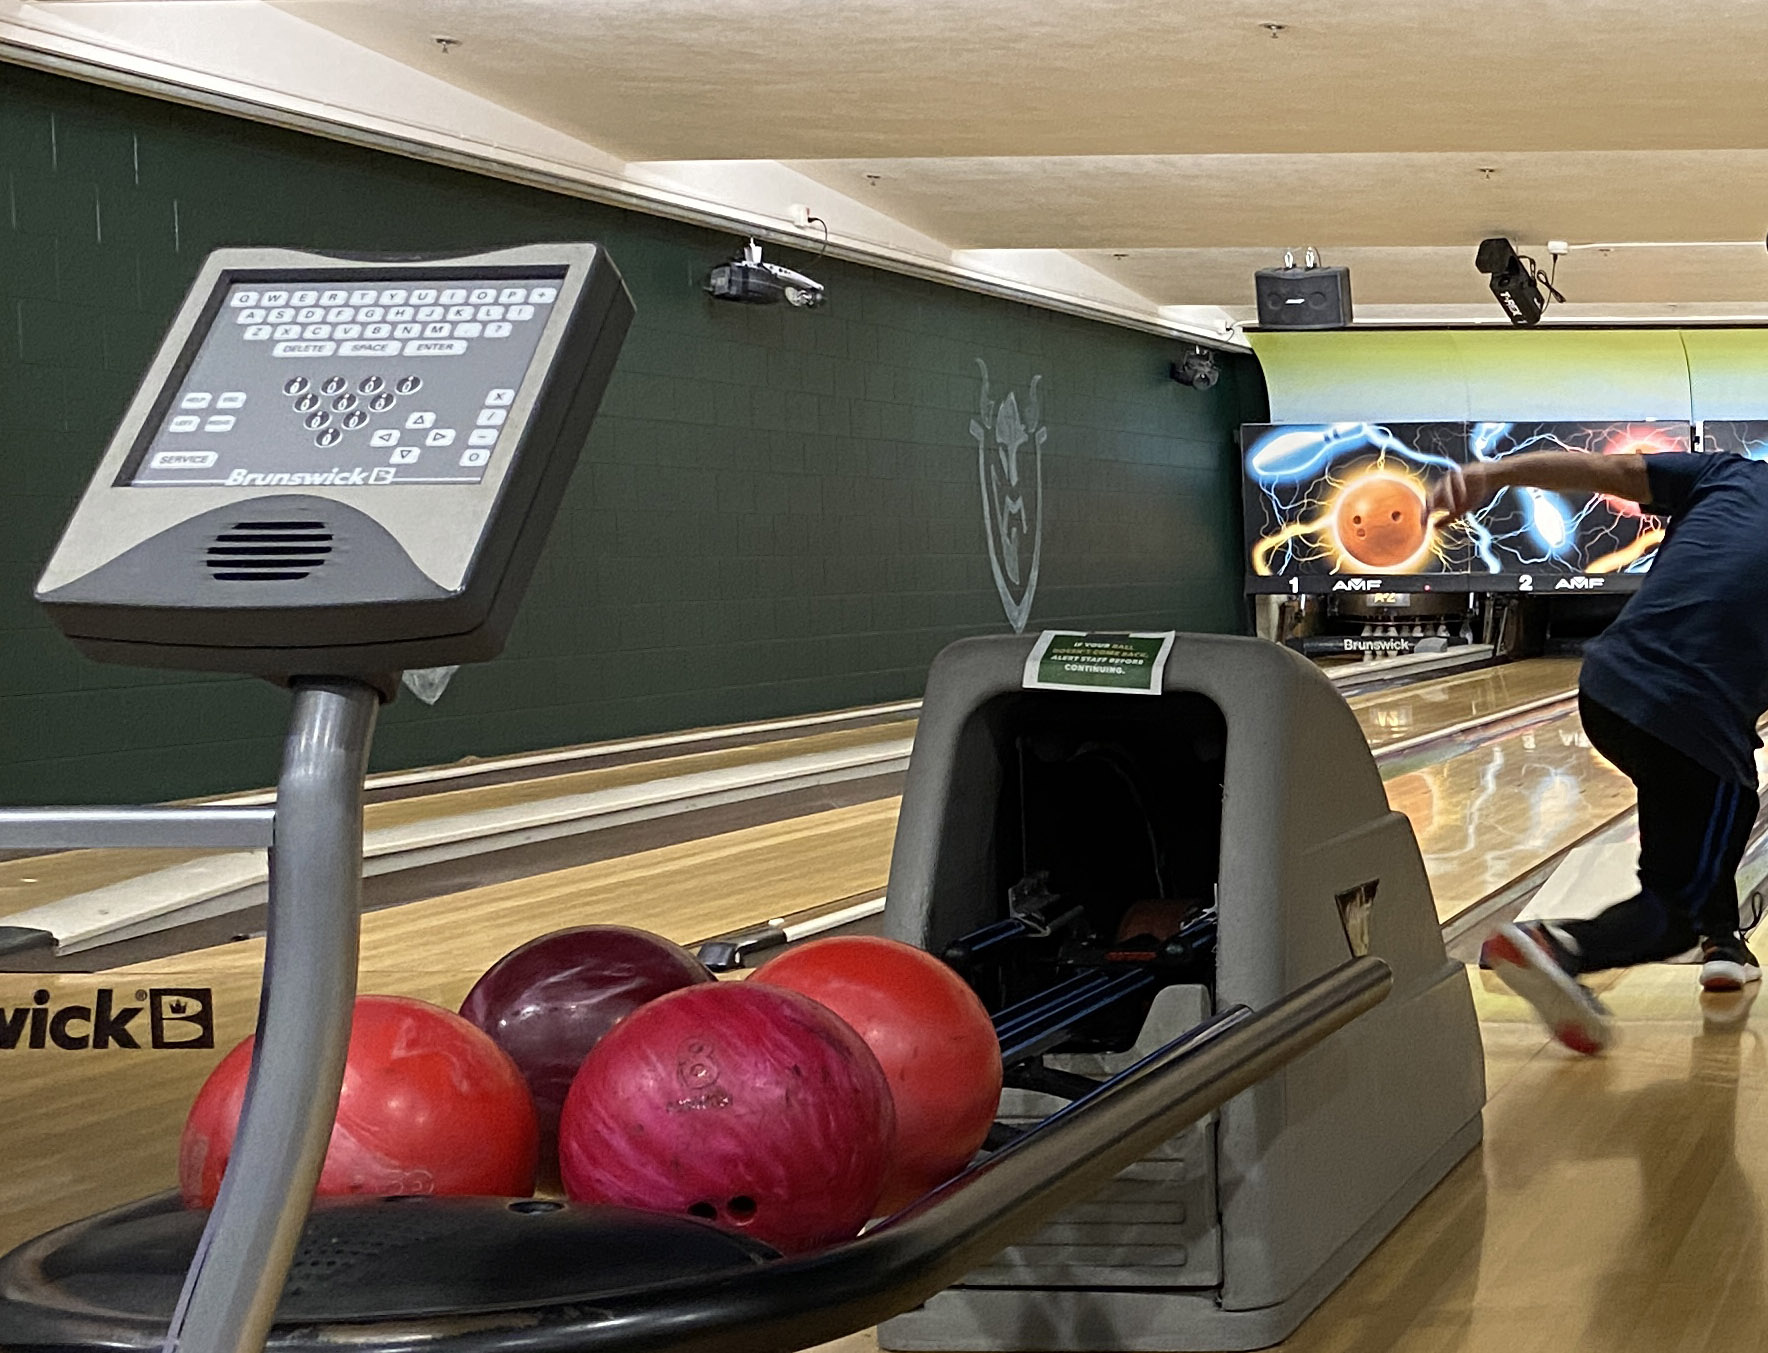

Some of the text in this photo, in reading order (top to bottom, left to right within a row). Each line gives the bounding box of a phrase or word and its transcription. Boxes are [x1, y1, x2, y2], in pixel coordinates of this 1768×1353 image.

[239, 295, 249, 303] Q
[268, 294, 281, 302] W
[300, 294, 308, 302] E
[329, 293, 338, 301] R
[418, 292, 428, 300] U
[477, 292, 488, 300] O
[508, 291, 516, 299] P
[245, 311, 255, 319] A
[276, 311, 285, 319] S
[305, 310, 315, 318] D
[336, 310, 344, 318] F
[365, 310, 375, 318] G
[426, 309, 434, 317] J
[252, 328, 263, 336] Z
[312, 327, 322, 335] C
[343, 327, 352, 335] V
[372, 327, 381, 335] B
[283, 345, 325, 353] DELETE
[417, 343, 454, 351] ENTER
[160, 455, 209, 464] SERVICE
[224, 467, 369, 486] Brunswick
[1288, 576, 1382, 594] 1 AMF
[1518, 574, 1605, 591] 2 AMF
[1343, 638, 1409, 651] Brunswick
[1050, 654, 1080, 662] ALERT
[1092, 649, 1120, 657] COME
[1064, 663, 1126, 675] CONTINUING.
